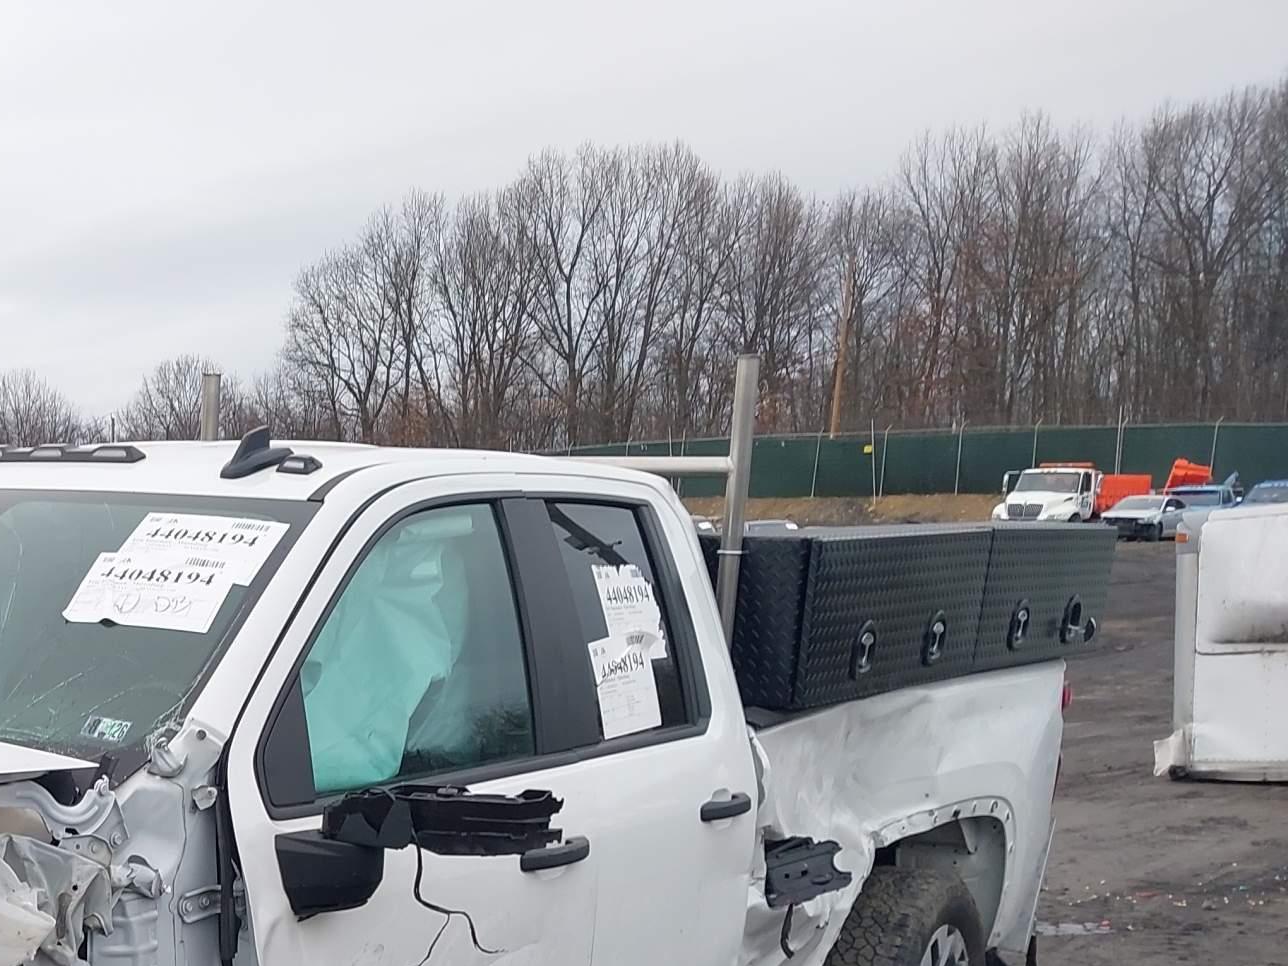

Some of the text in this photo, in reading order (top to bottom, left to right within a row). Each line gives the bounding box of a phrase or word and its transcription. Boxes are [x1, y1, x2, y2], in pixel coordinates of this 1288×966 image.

[146, 527, 260, 548] 44048194
[100, 566, 216, 586] 44048194
[605, 584, 651, 604] 44048194
